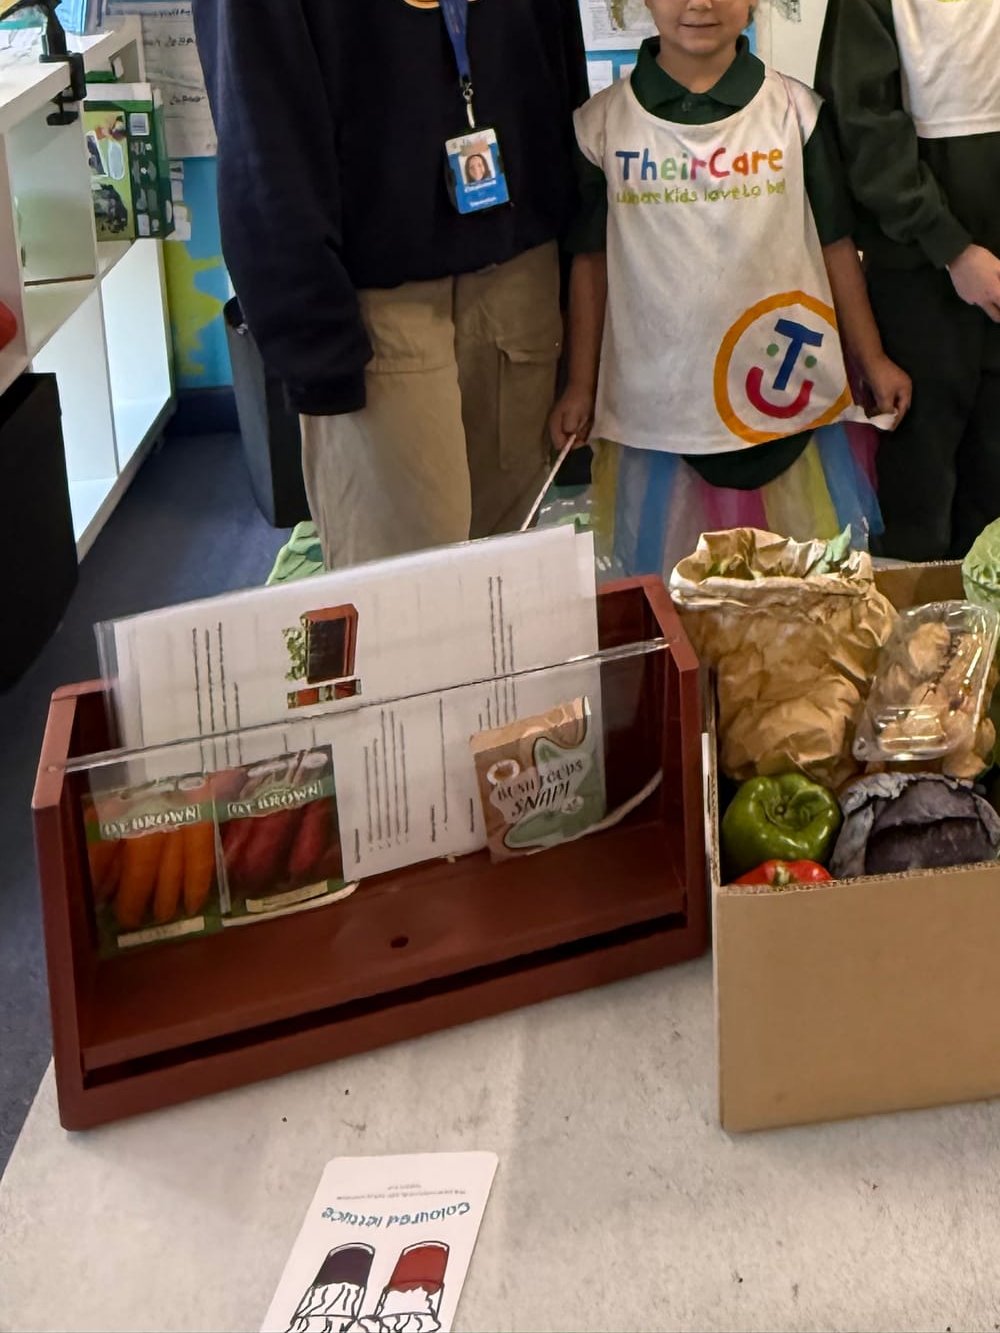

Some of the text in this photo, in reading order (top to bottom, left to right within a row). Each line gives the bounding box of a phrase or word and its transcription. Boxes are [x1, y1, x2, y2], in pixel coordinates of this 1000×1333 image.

[615, 147, 784, 181] TheirCare
[257, 782, 319, 810] BROWN
[131, 805, 198, 831] BROWN
[321, 1201, 471, 1228] Coloured lettuce
